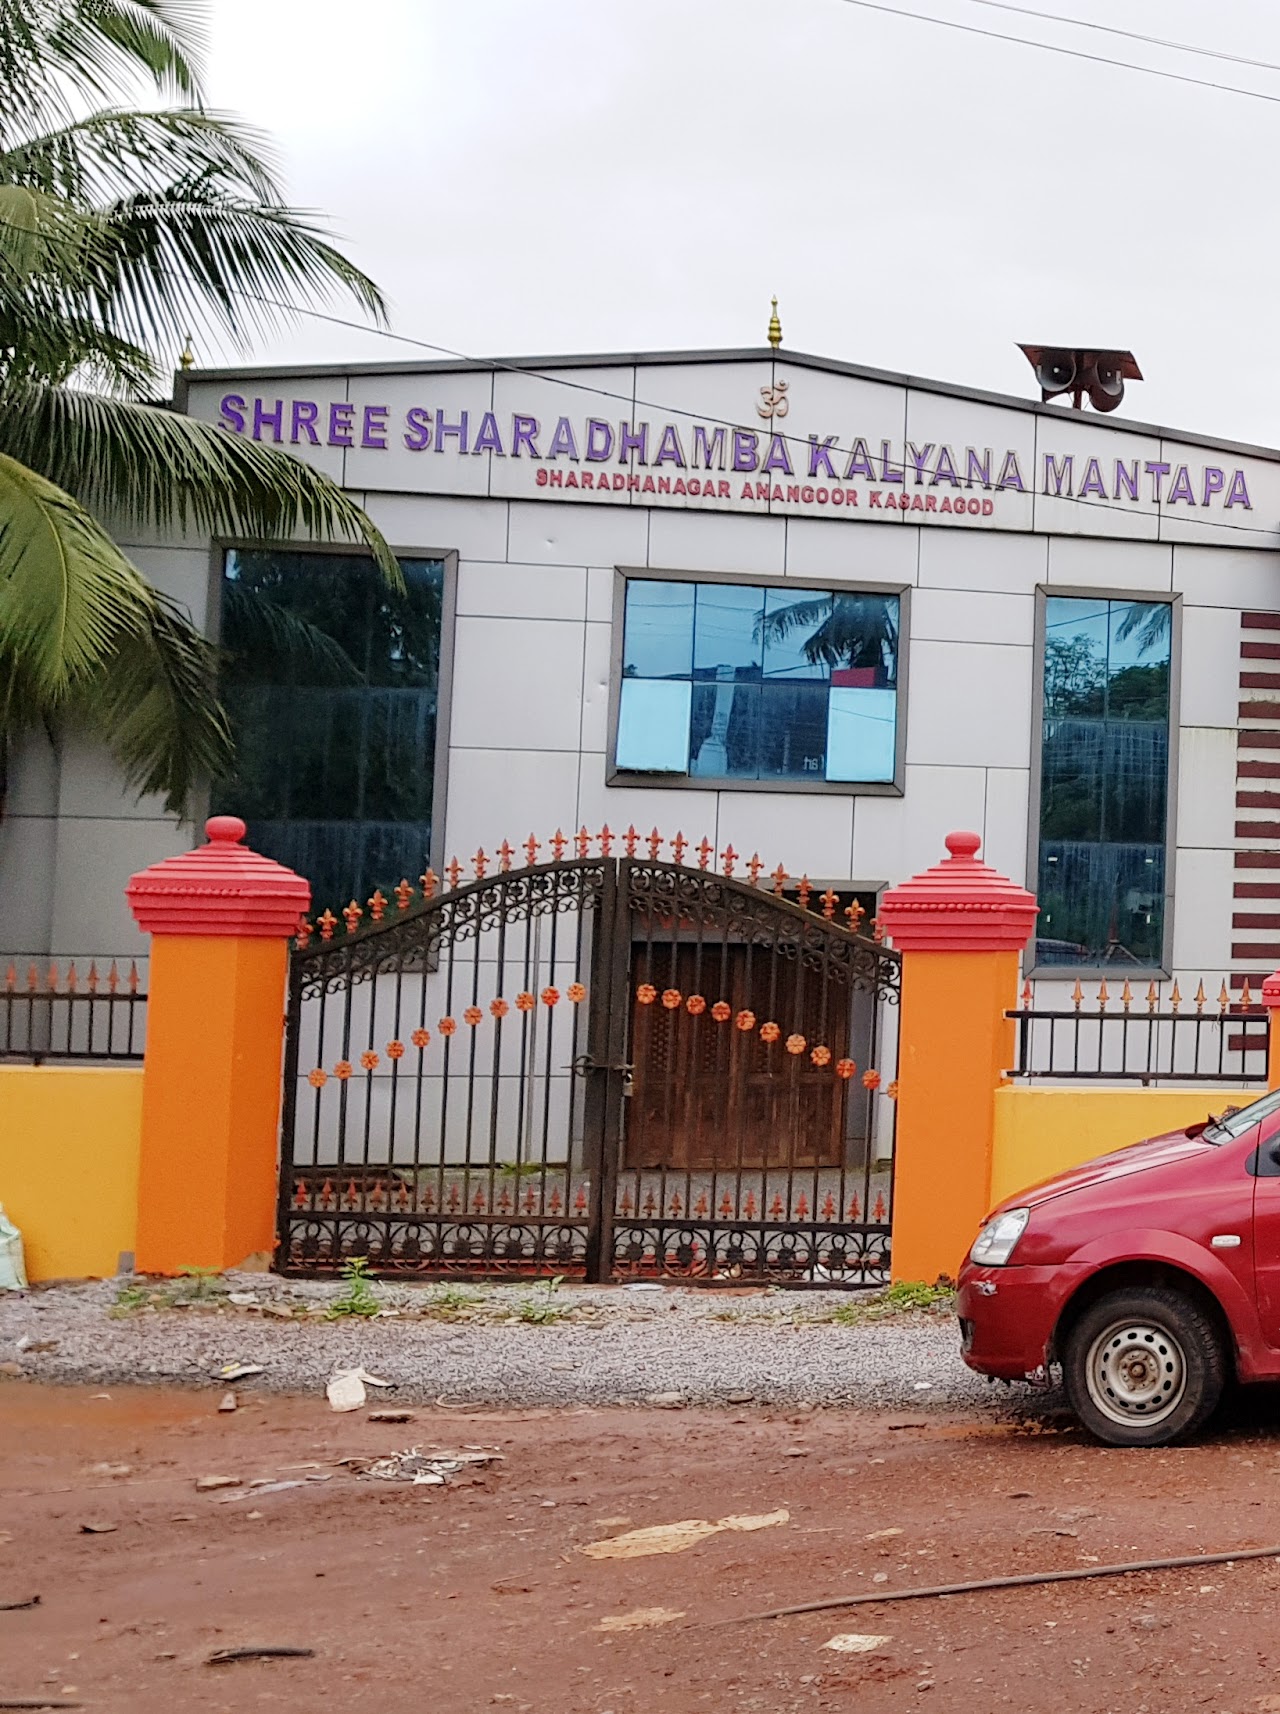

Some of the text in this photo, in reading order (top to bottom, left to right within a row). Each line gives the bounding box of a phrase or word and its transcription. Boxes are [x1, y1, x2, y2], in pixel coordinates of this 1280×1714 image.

[217, 392, 1254, 511] SHREE SHARADHAMBA KALYANA MANTAPA
[535, 467, 993, 517] SHARADHANAGAR ANANGOOR KASARAGOD
